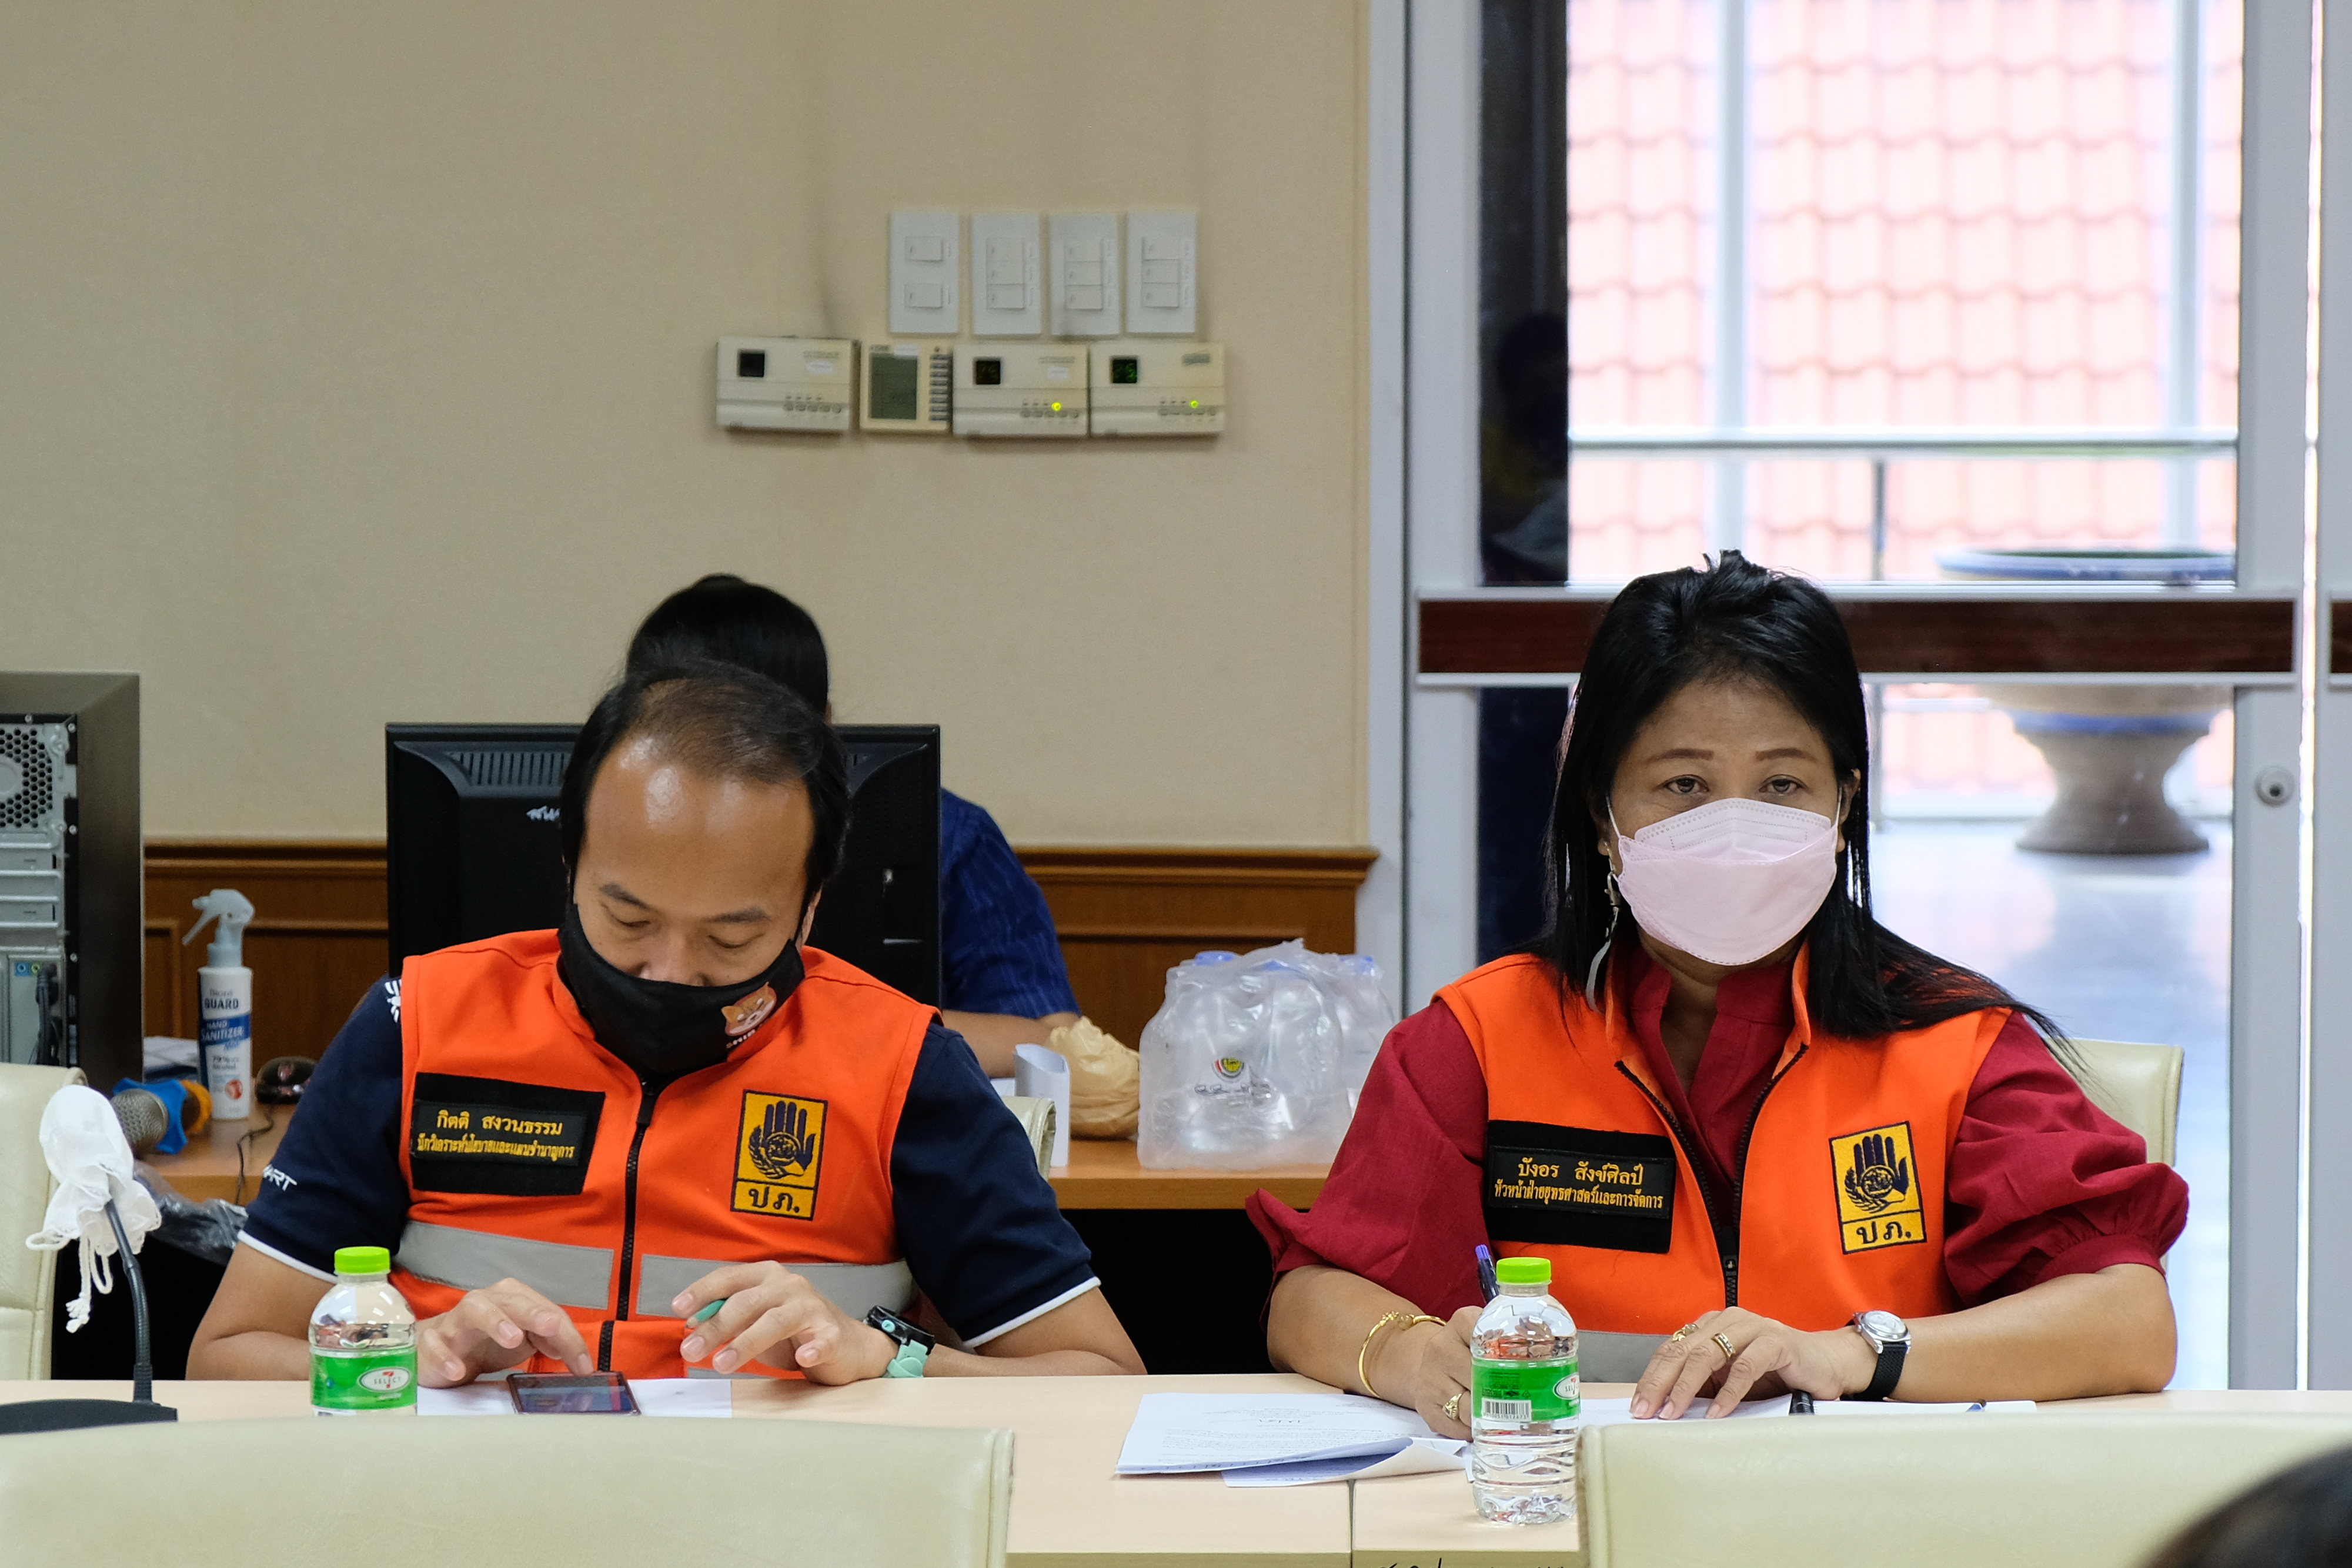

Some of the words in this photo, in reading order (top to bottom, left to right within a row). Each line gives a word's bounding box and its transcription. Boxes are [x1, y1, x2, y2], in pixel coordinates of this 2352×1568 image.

[204, 998, 239, 1009] GUARD
[437, 1109, 470, 1129] กิตติ
[482, 1115, 563, 1135] สงวนธรรม
[1518, 1156, 1560, 1178] บังอร
[1575, 1161, 1643, 1186] สังข์ศิลป์
